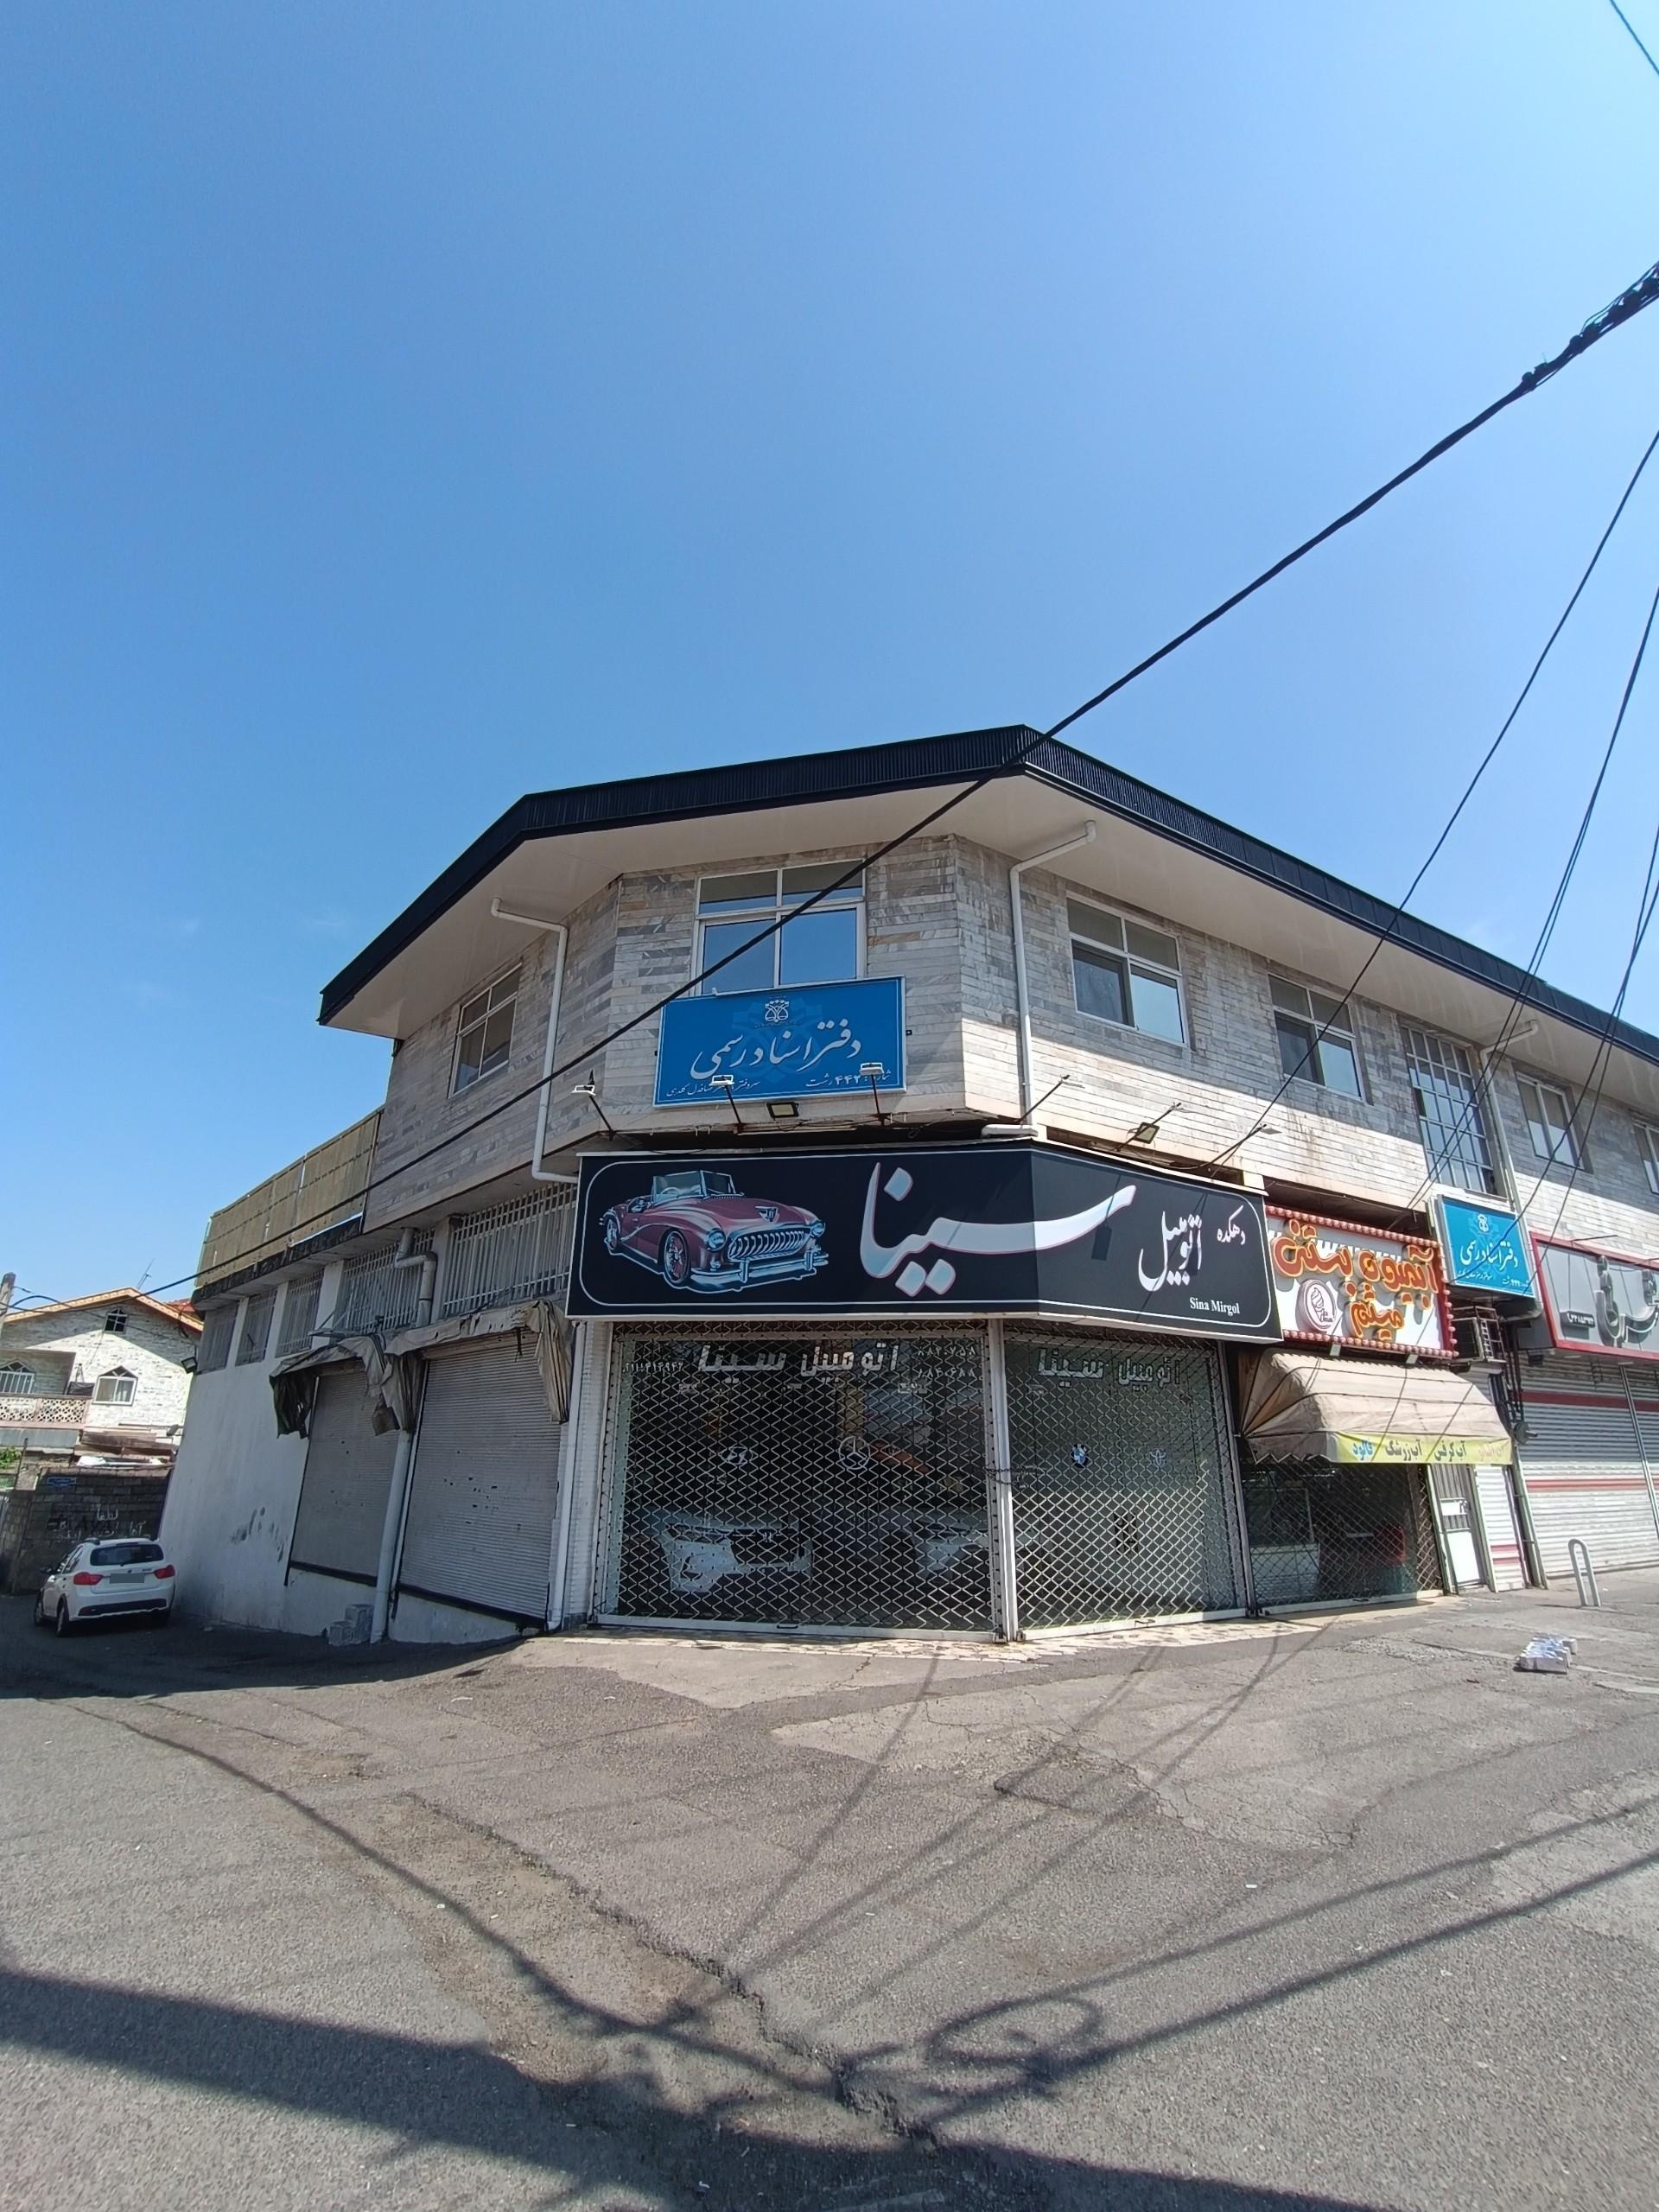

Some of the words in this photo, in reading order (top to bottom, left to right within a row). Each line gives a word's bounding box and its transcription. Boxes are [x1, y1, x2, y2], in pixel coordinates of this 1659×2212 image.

[690, 1033, 747, 1080] رسمی
[749, 1030, 813, 1066] اسناد
[796, 1018, 861, 1072] دفتر
[859, 1161, 1137, 1298] سینا
[1216, 1204, 1246, 1246] دهکده
[1138, 1210, 1203, 1293] اتومبیل
[1273, 1218, 1357, 1298] بستنی
[1499, 1241, 1518, 1271] دفتر
[1189, 1296, 1210, 1311] Sina
[1210, 1299, 1240, 1317] Mirgol
[698, 1344, 787, 1383] سینا
[800, 1342, 899, 1387] اتومبیل
[1037, 1347, 1105, 1388] سینا
